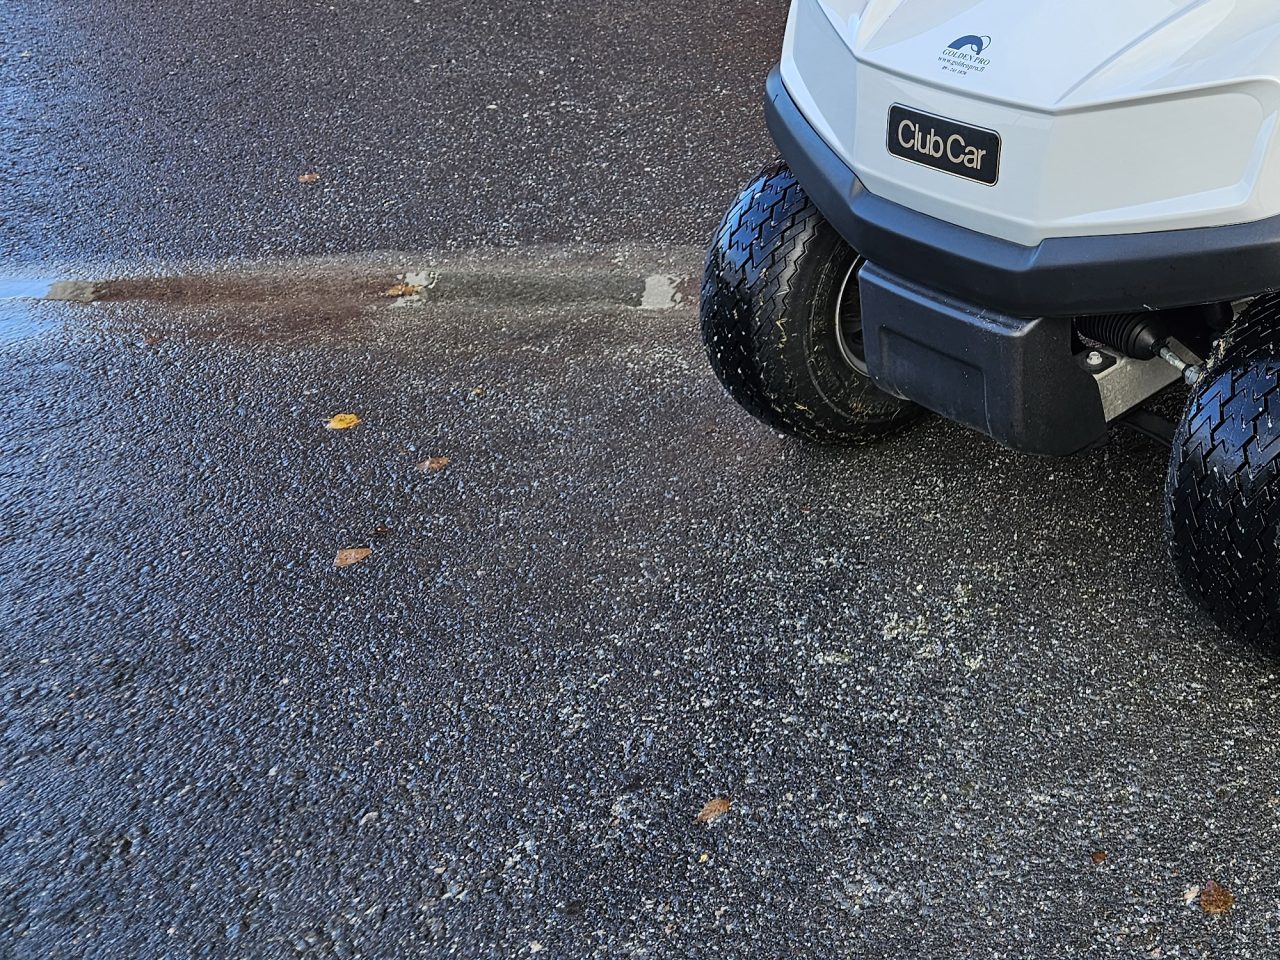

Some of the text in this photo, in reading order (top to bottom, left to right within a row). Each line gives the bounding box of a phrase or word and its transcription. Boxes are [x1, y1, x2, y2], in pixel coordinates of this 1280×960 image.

[942, 48, 991, 66] GOLDEN PRO
[897, 119, 987, 170] Club Car
